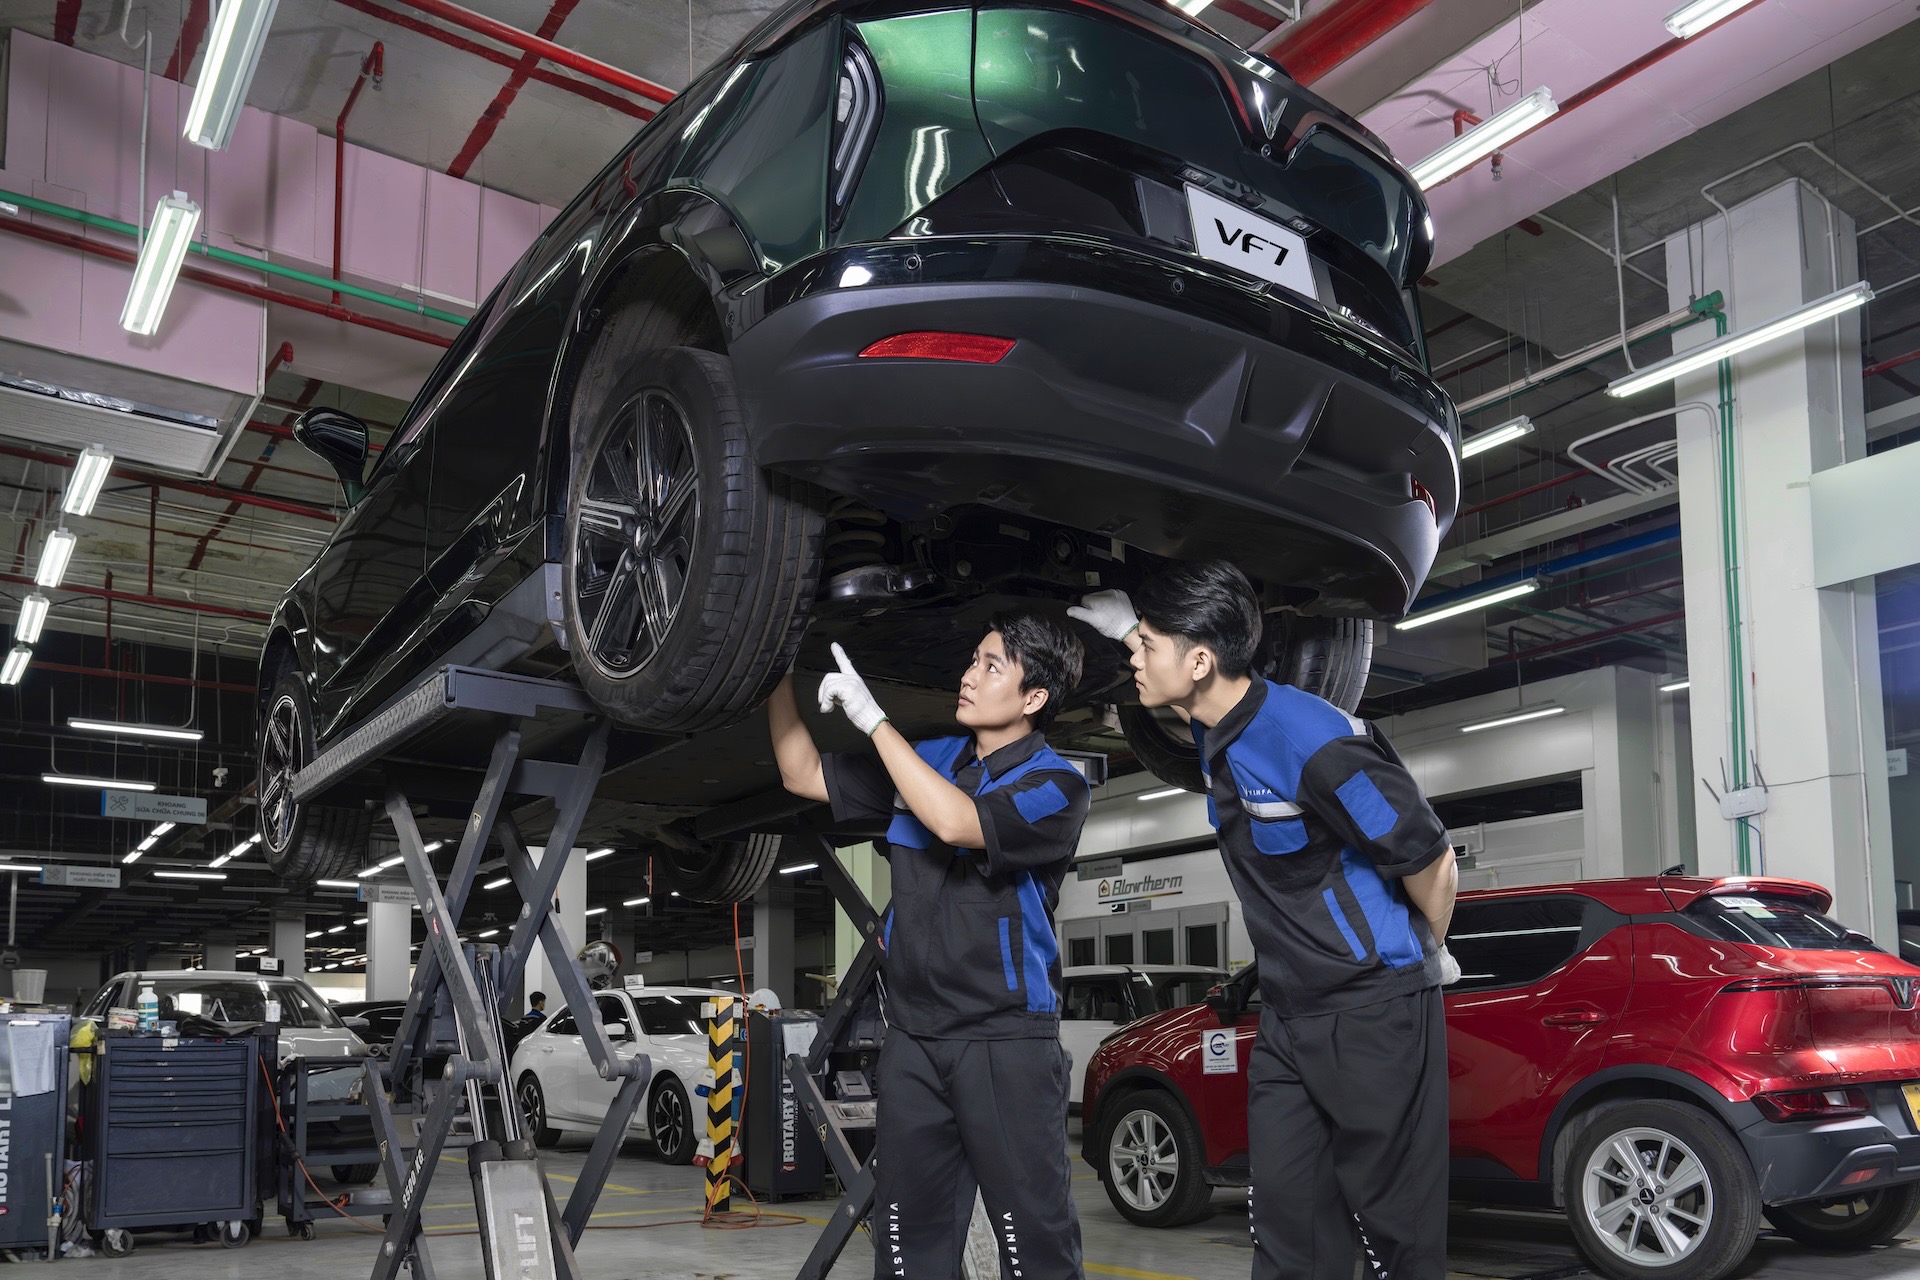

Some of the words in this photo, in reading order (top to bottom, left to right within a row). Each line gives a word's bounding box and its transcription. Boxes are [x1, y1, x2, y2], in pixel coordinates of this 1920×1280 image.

[1214, 217, 1289, 266] VF7
[1112, 875, 1183, 896] Blowtherm
[783, 1097, 795, 1162] ROTARY
[402, 1170, 416, 1209] 3500
[415, 1149, 425, 1174] KG
[514, 1213, 539, 1266] LIFT
[890, 1203, 906, 1277] VINFAST
[1003, 1212, 1022, 1277] VINFAS
